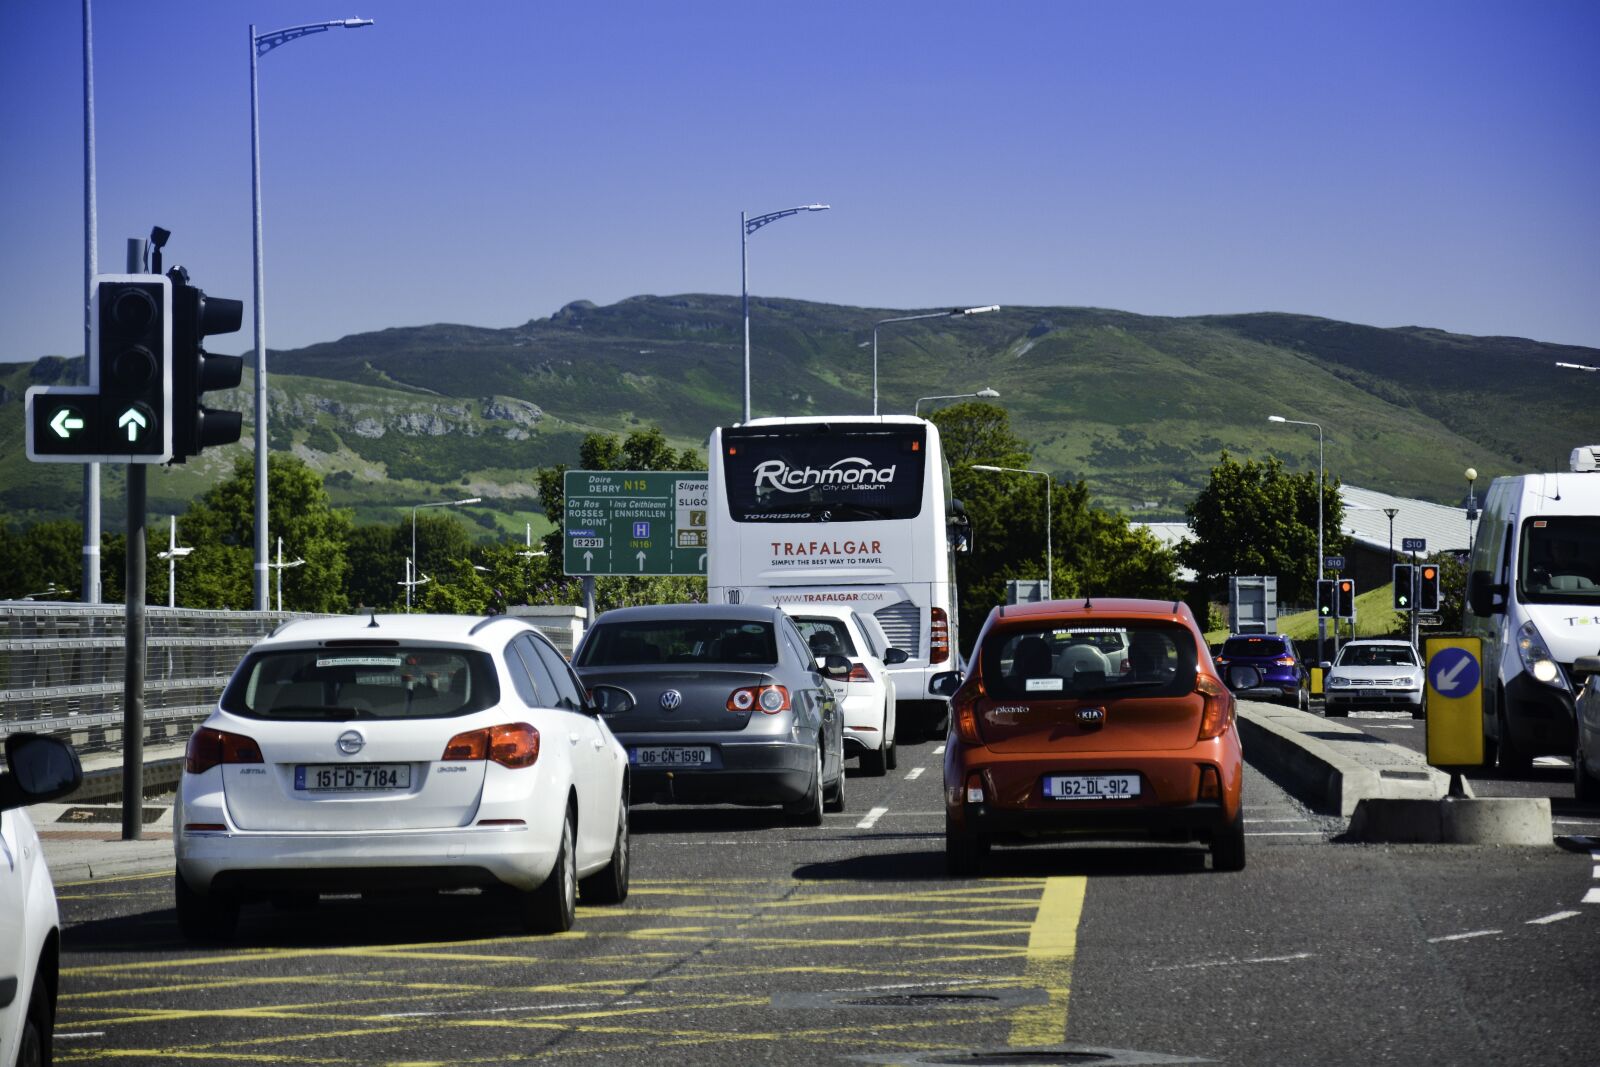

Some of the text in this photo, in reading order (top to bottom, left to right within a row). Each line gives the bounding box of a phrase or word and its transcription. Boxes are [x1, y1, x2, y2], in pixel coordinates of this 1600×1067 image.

[753, 459, 896, 493] Richmond
[590, 485, 621, 493] DERRY
[624, 480, 647, 490] N15
[678, 482, 708, 491] Sligeac
[583, 500, 600, 508] Ros
[678, 498, 708, 506] SLIGO
[614, 510, 666, 518] ENNISKILLEN
[743, 512, 811, 520] TOURISMO
[581, 518, 607, 526] POINT
[636, 524, 647, 537] H
[771, 541, 882, 556] TRAFALGAR
[727, 589, 740, 605] 100
[772, 592, 884, 603] WWW.TRAFALGAR.COM
[1081, 711, 1099, 719] KIA
[642, 750, 706, 762] 06-CN-1590
[316, 769, 398, 787] 151-D-7184
[1060, 779, 1129, 795] 162-DL-912
